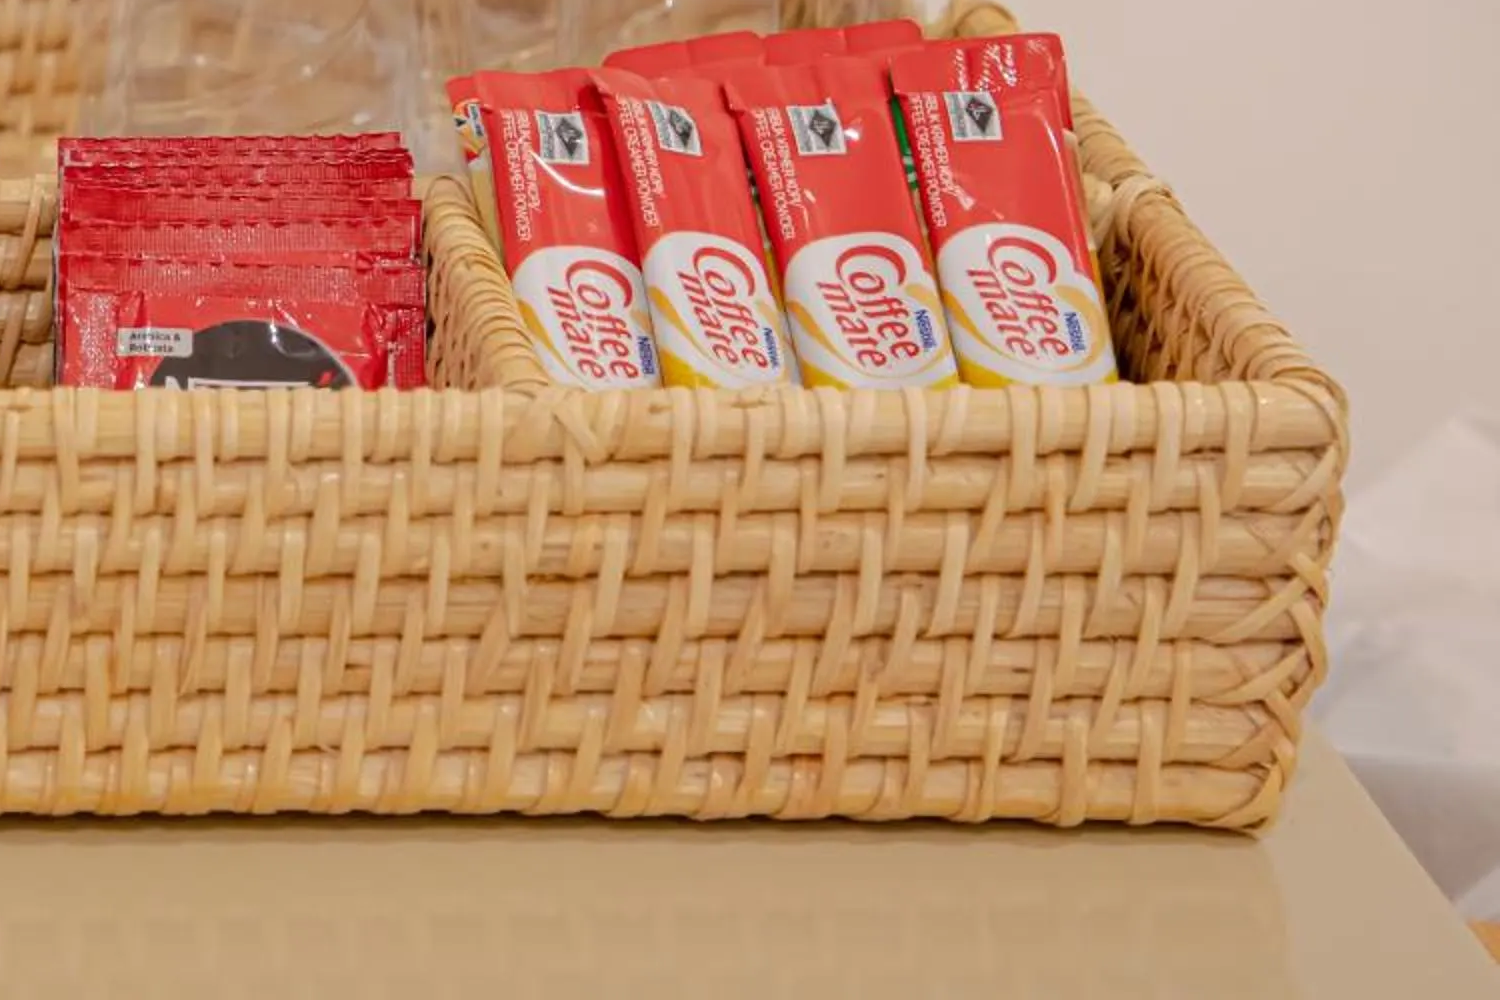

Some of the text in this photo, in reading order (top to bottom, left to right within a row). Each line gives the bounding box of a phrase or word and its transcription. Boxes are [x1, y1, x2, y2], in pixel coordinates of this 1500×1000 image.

[546, 286, 605, 378] mate
[565, 260, 639, 378] Coffee
[677, 271, 738, 364] mate
[693, 247, 768, 368] Coffee
[817, 281, 886, 367] mate
[835, 245, 919, 358] Coffee
[967, 269, 1035, 355] mate
[987, 237, 1068, 356] Coffee
